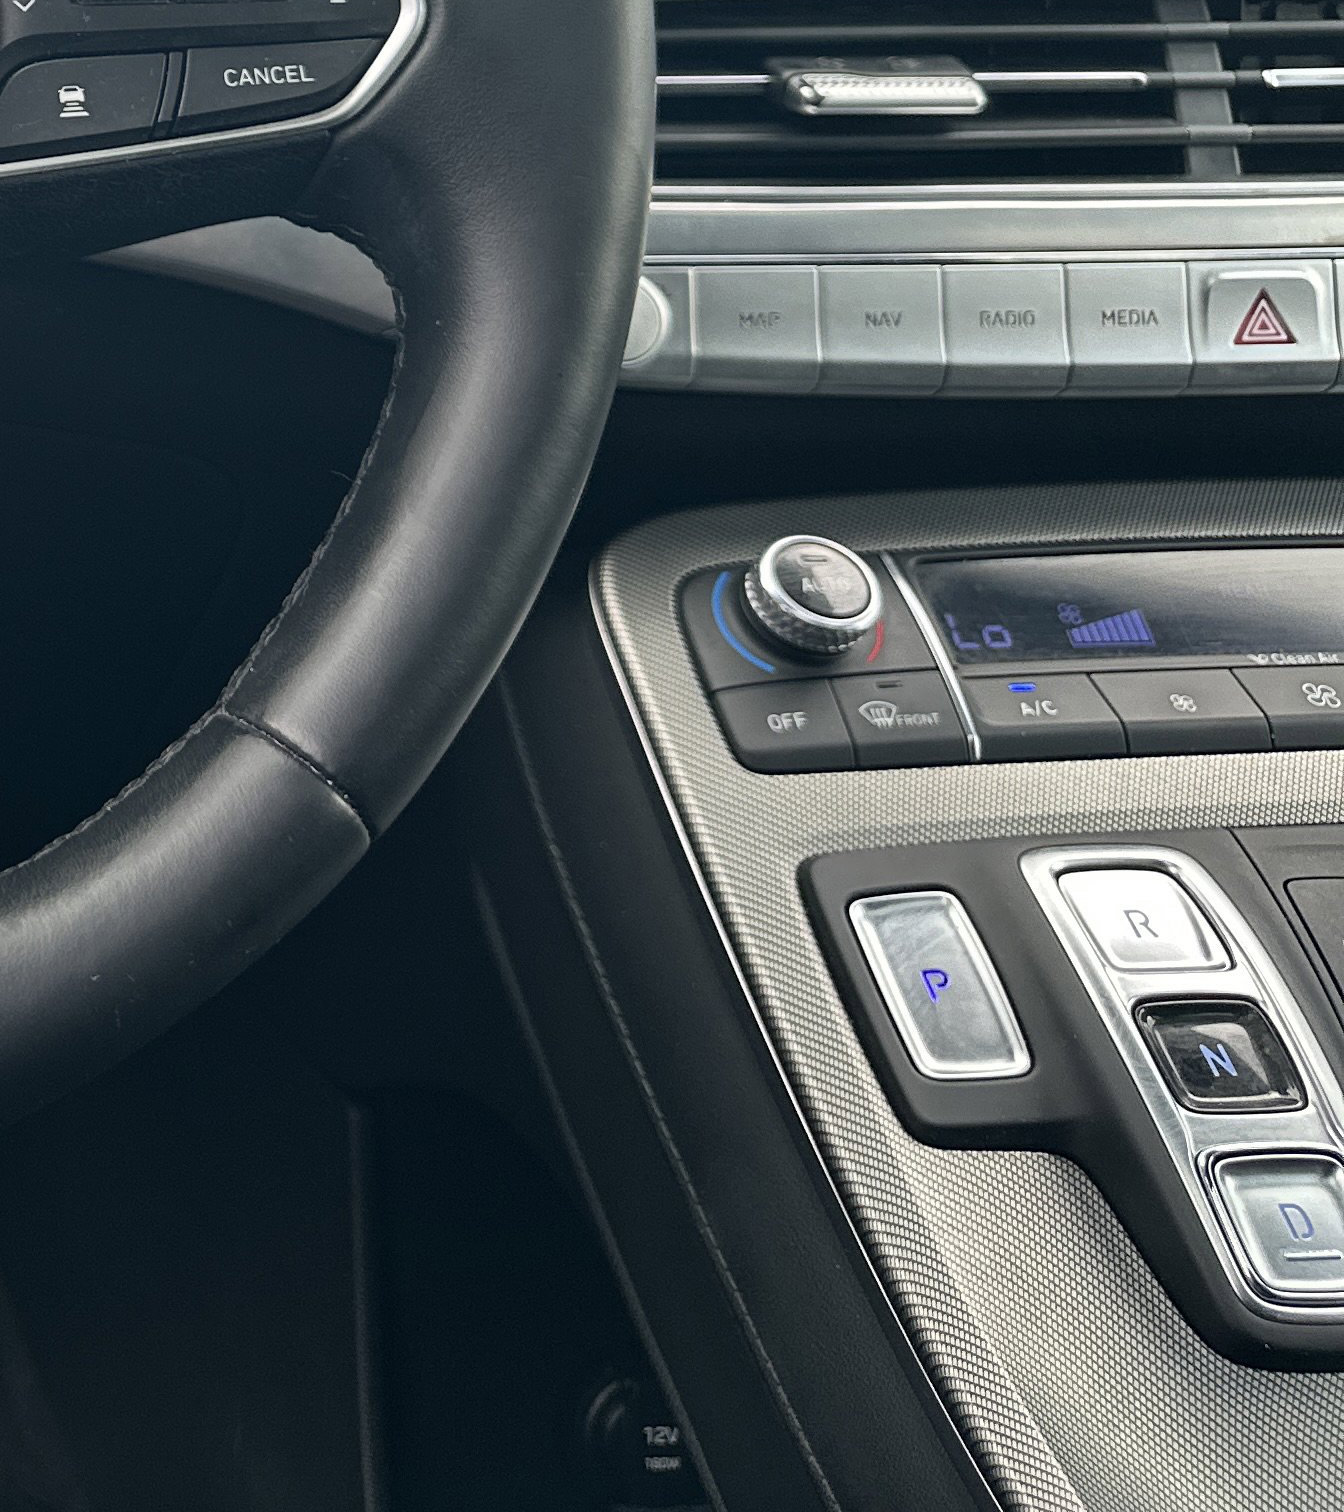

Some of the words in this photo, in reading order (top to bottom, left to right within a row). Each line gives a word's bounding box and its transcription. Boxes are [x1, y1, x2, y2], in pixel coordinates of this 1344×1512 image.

[222, 63, 316, 88] CANCEL
[738, 311, 782, 329] MAP
[864, 310, 903, 329] NAV
[979, 310, 1037, 329] RADIO
[1100, 309, 1160, 328] MEDIA
[1019, 699, 1058, 718] A/C
[767, 710, 808, 733] OFF
[1122, 909, 1160, 939] R
[921, 968, 952, 1003] P
[1199, 1043, 1239, 1079] N
[1278, 1203, 1316, 1240] D
[643, 1425, 680, 1446] 12V
